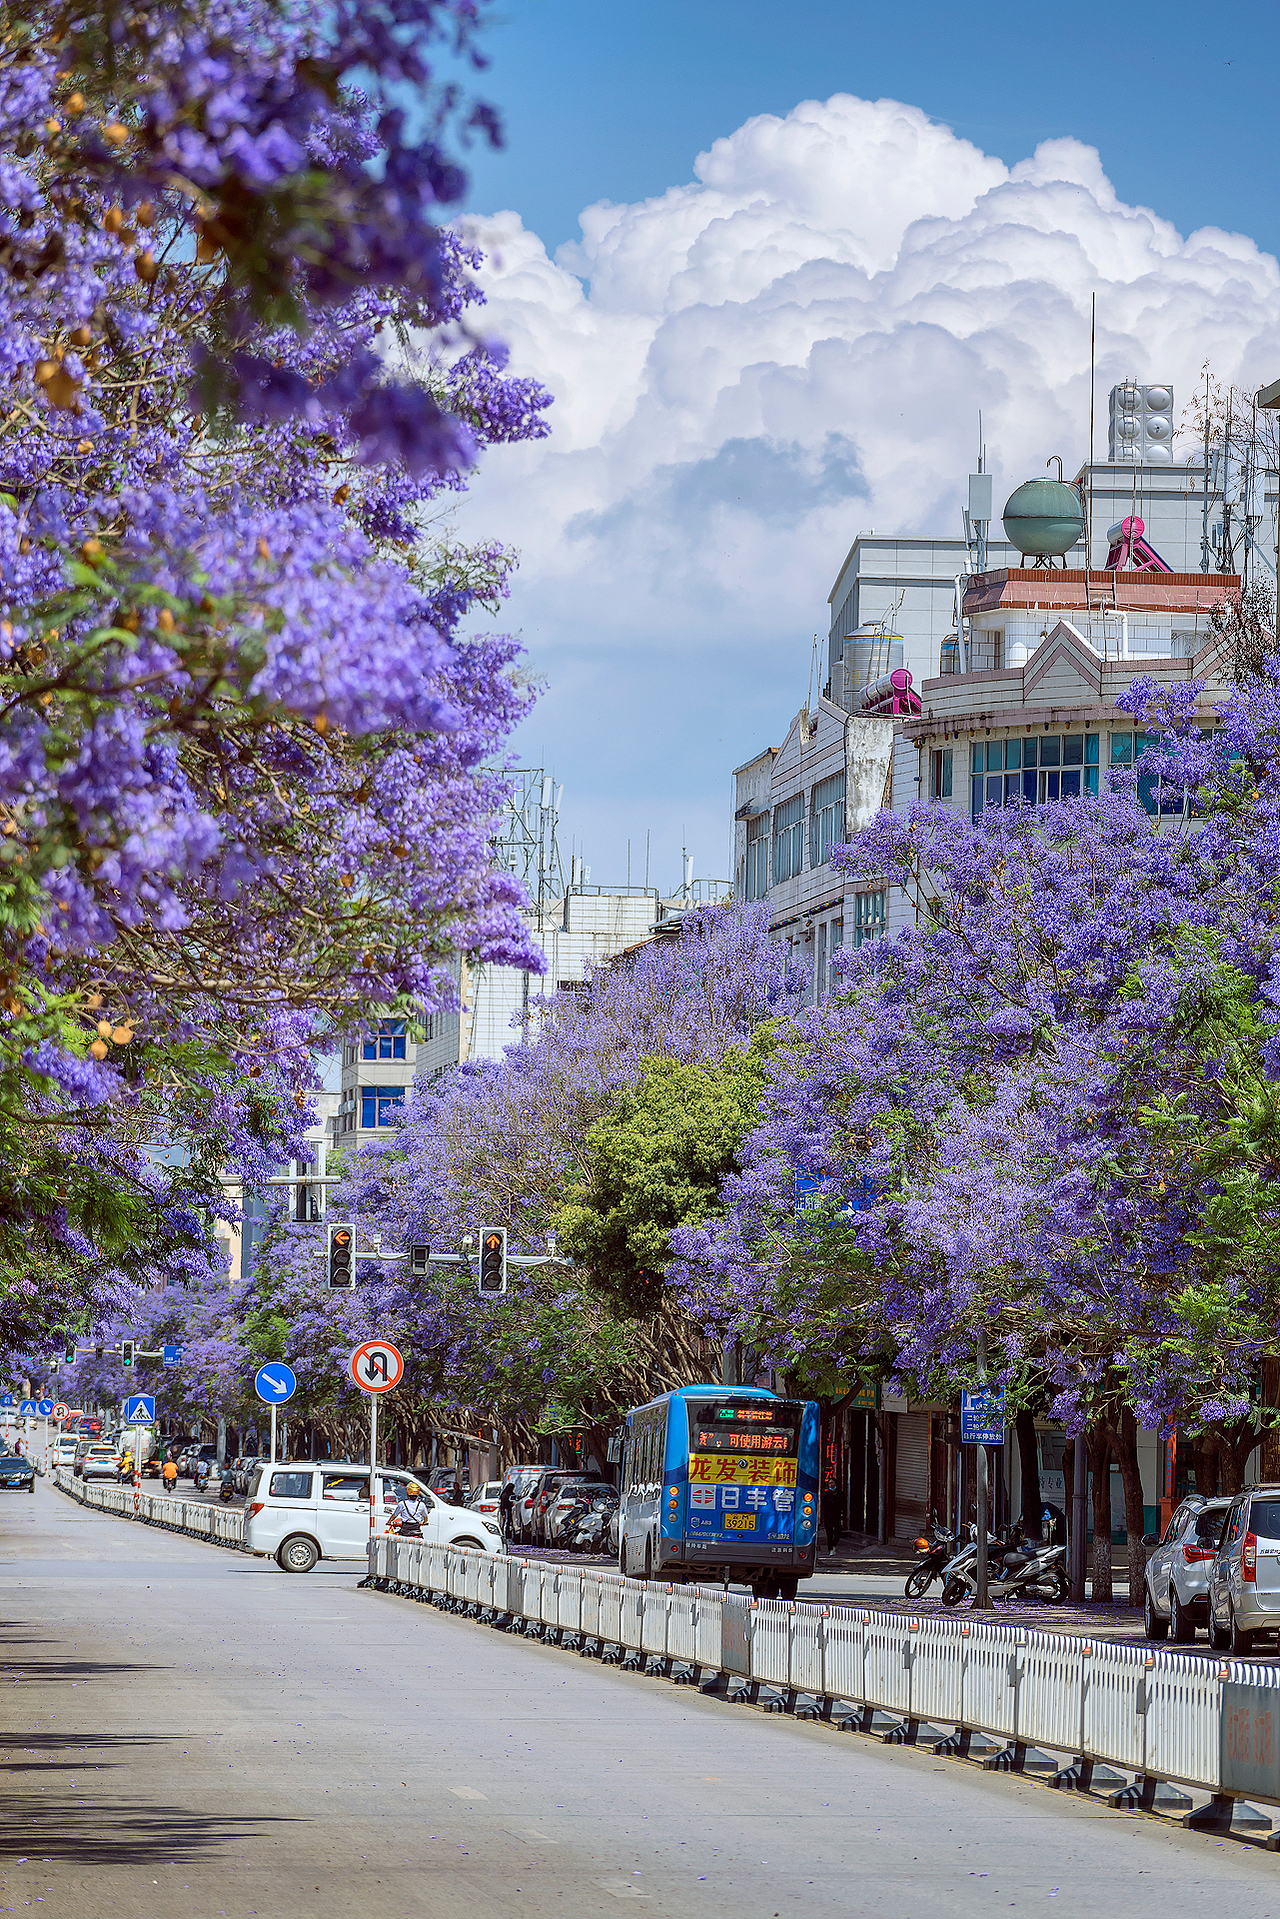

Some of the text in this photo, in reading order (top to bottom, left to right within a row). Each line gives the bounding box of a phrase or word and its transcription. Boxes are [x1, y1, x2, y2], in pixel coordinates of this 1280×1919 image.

[963, 1432, 1003, 1441] 自行车停放处
[689, 1457, 796, 1485] 龙发装饰
[721, 1486, 795, 1512] 日丰管
[726, 1519, 754, 1529] 39215
